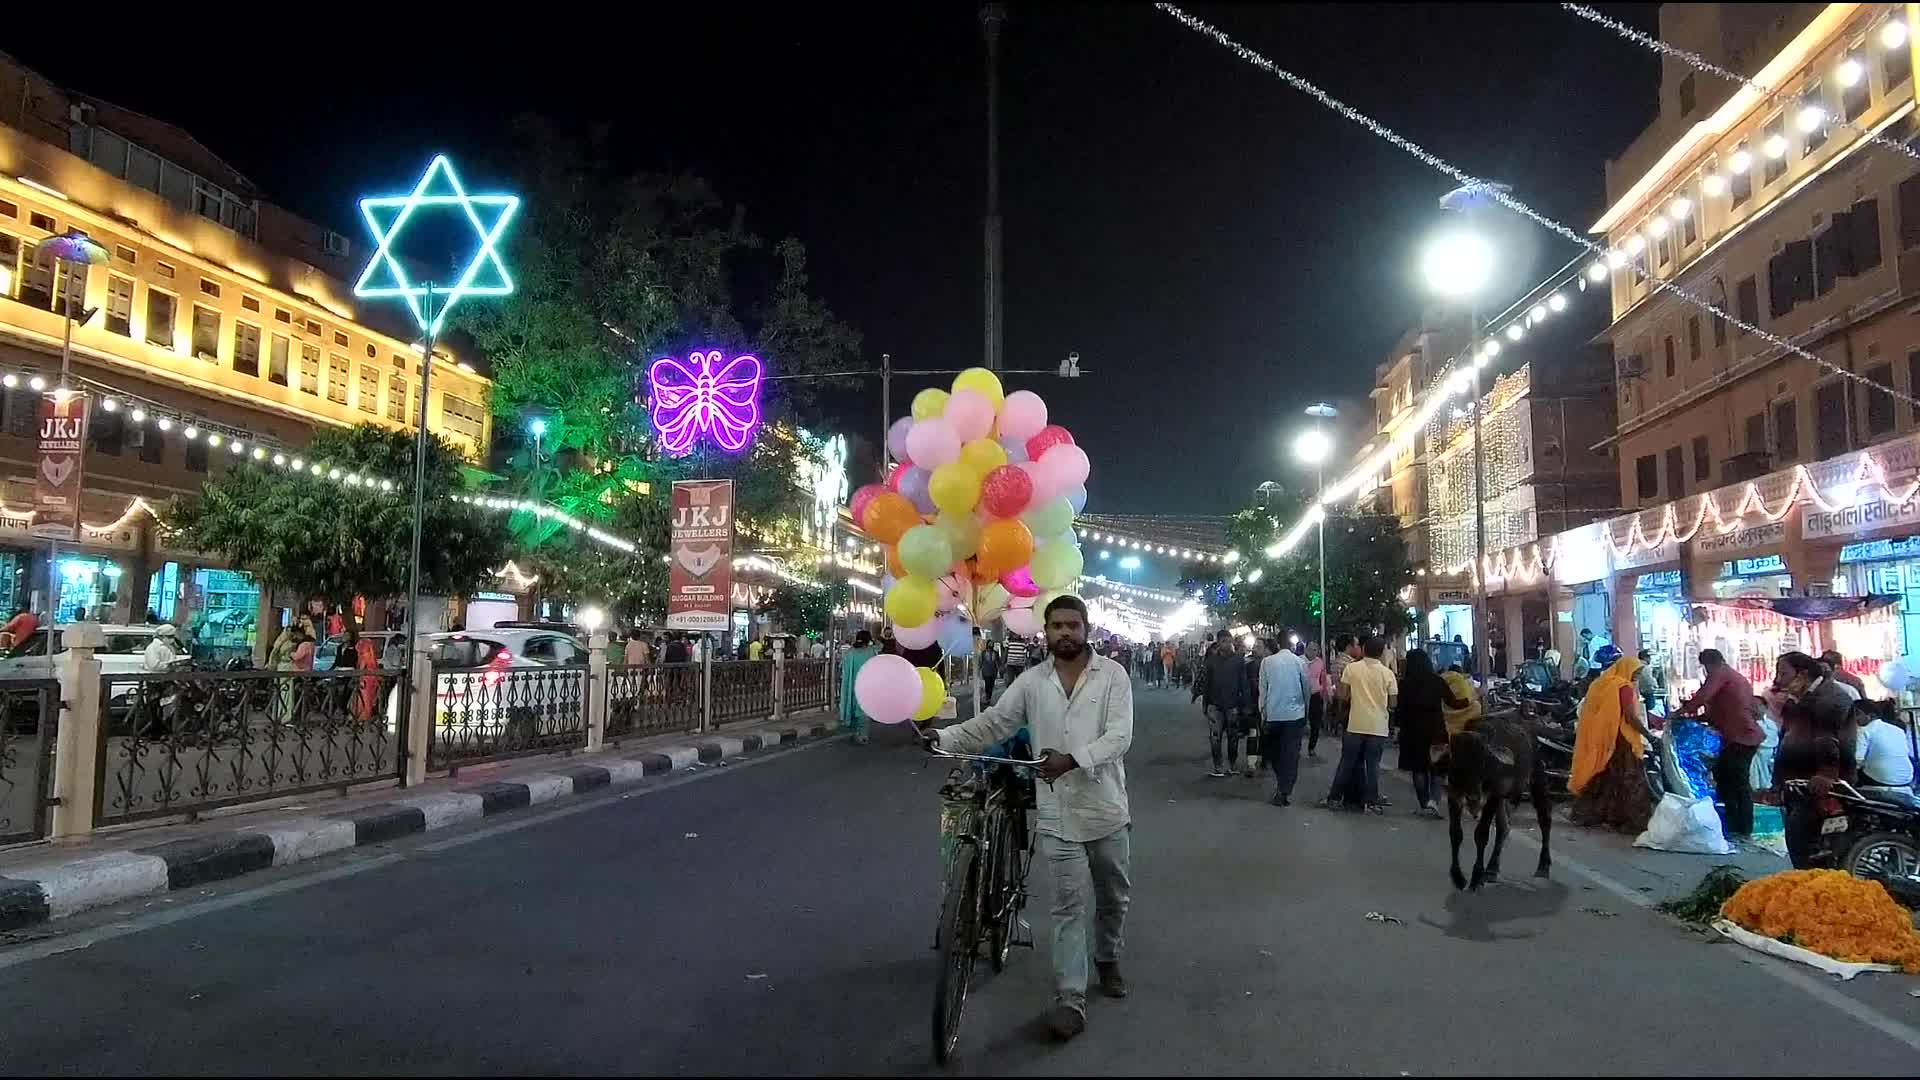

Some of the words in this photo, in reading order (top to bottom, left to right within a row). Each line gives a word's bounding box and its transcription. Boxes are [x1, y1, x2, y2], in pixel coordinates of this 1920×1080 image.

[40, 418, 81, 438] JKJ
[39, 440, 80, 449] JEWELLERS
[672, 505, 728, 528] JKJ
[672, 528, 728, 538] JEWELLERS
[697, 594, 724, 602] BUILDING
